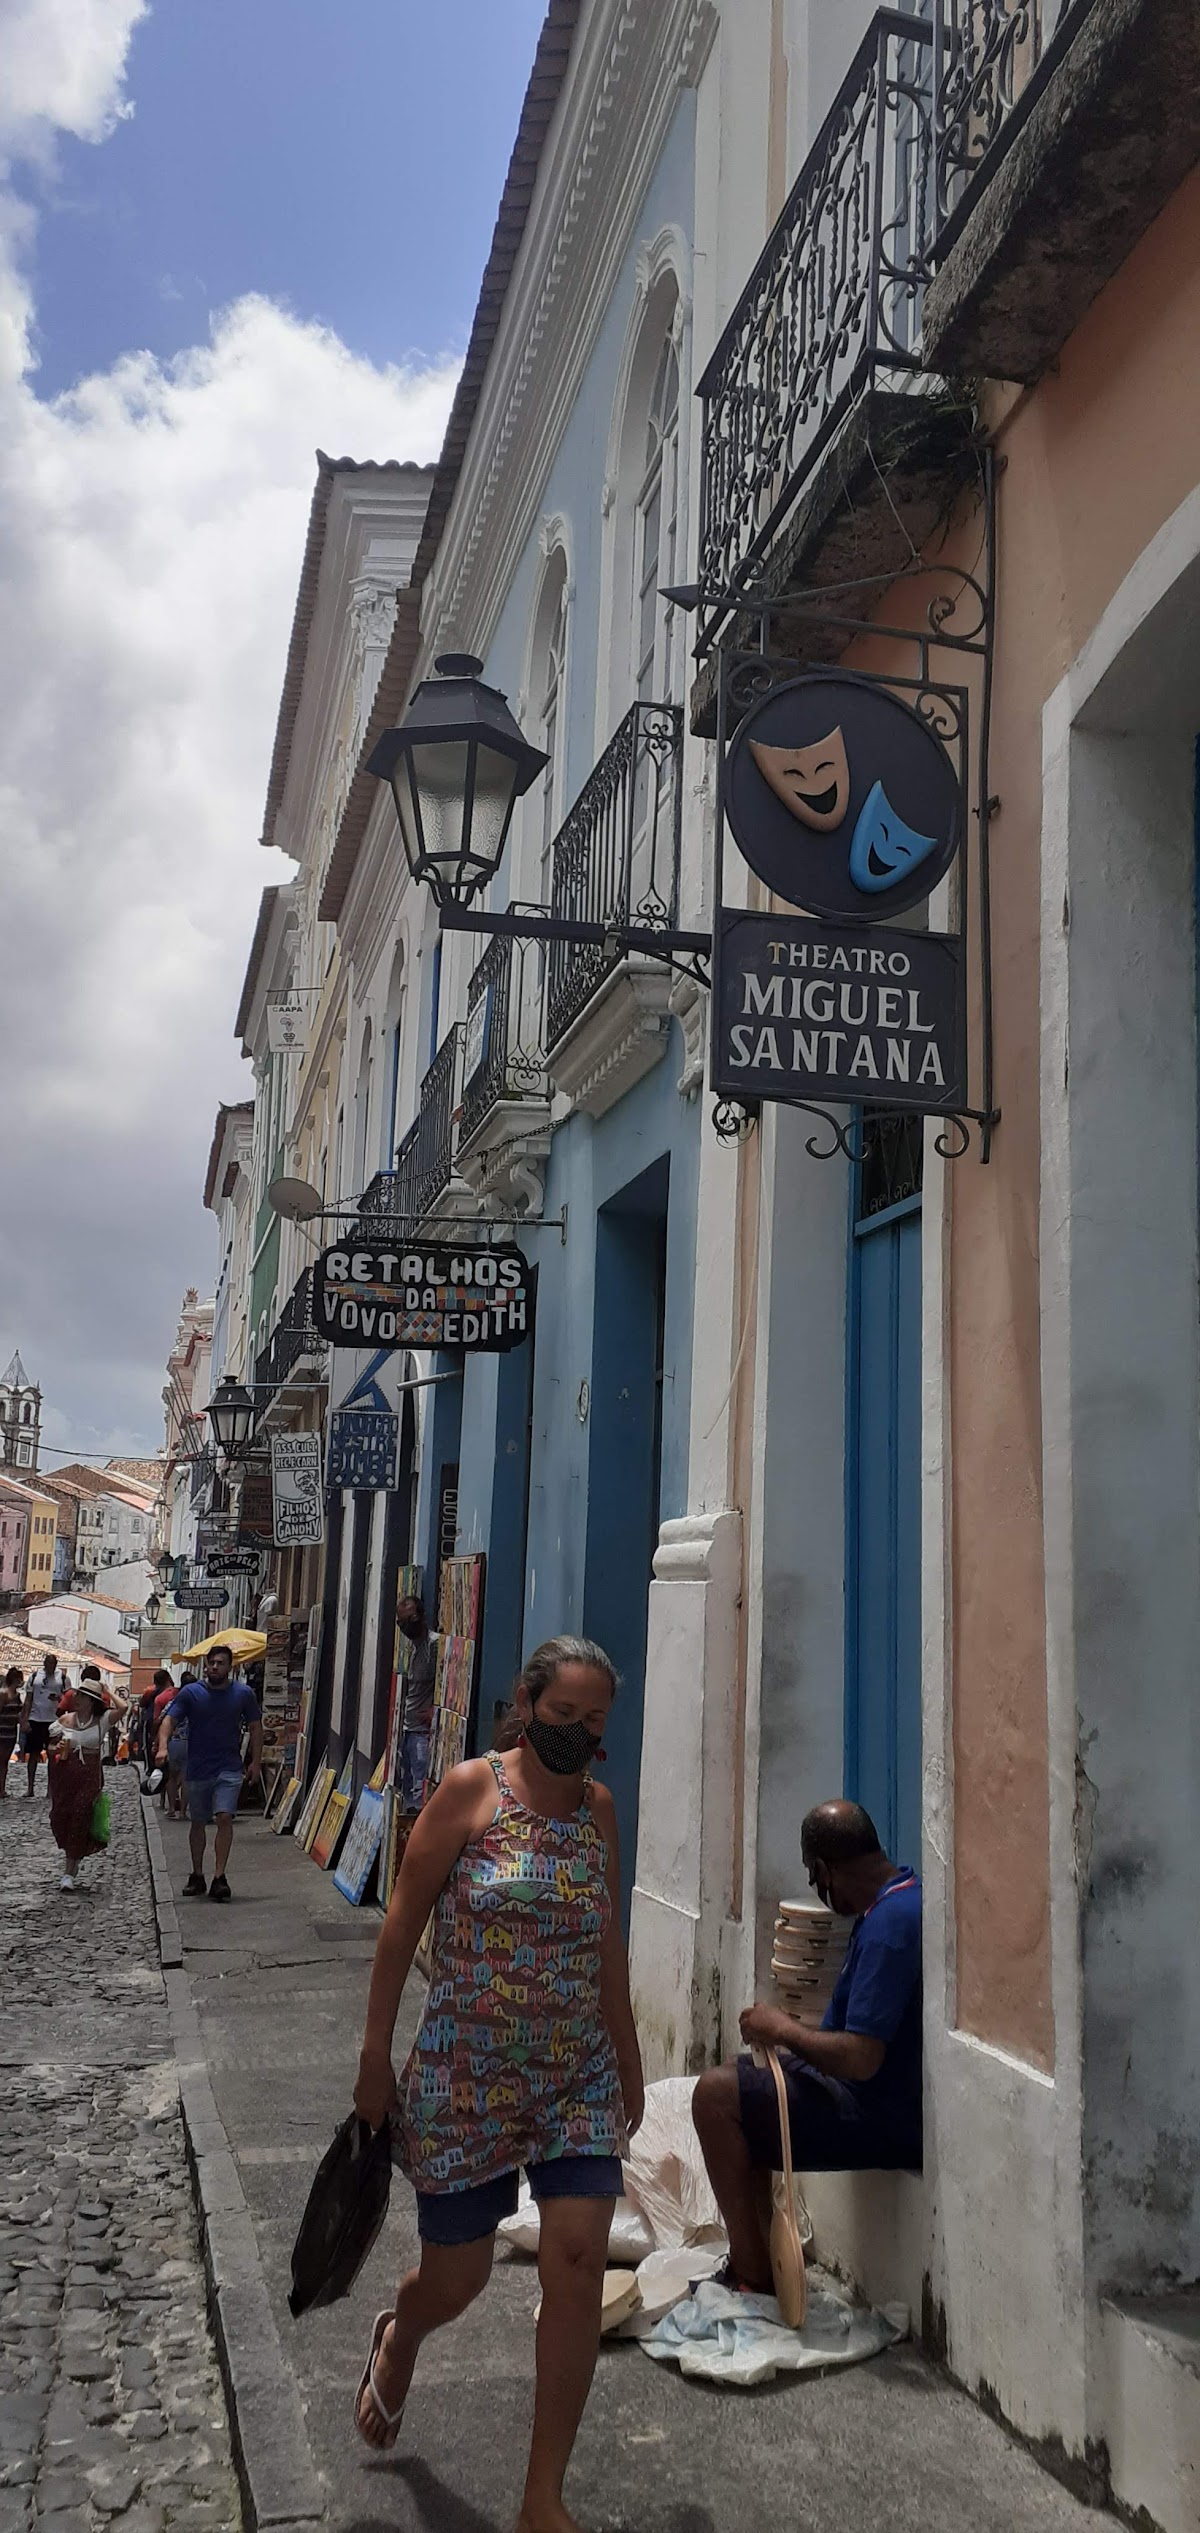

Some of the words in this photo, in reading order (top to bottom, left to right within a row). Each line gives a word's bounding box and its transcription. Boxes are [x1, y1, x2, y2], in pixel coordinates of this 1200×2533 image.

[767, 941, 911, 976] THEATRO
[741, 972, 936, 1033] MIGUEL
[728, 1024, 946, 1086] SANTANA
[326, 1252, 522, 1288] RETALHOS
[406, 1287, 436, 1310] DA
[443, 1301, 526, 1343] EDITH
[279, 1499, 316, 1518] FILHOS
[291, 1515, 306, 1524] DE
[277, 1517, 320, 1539] GANDHY
